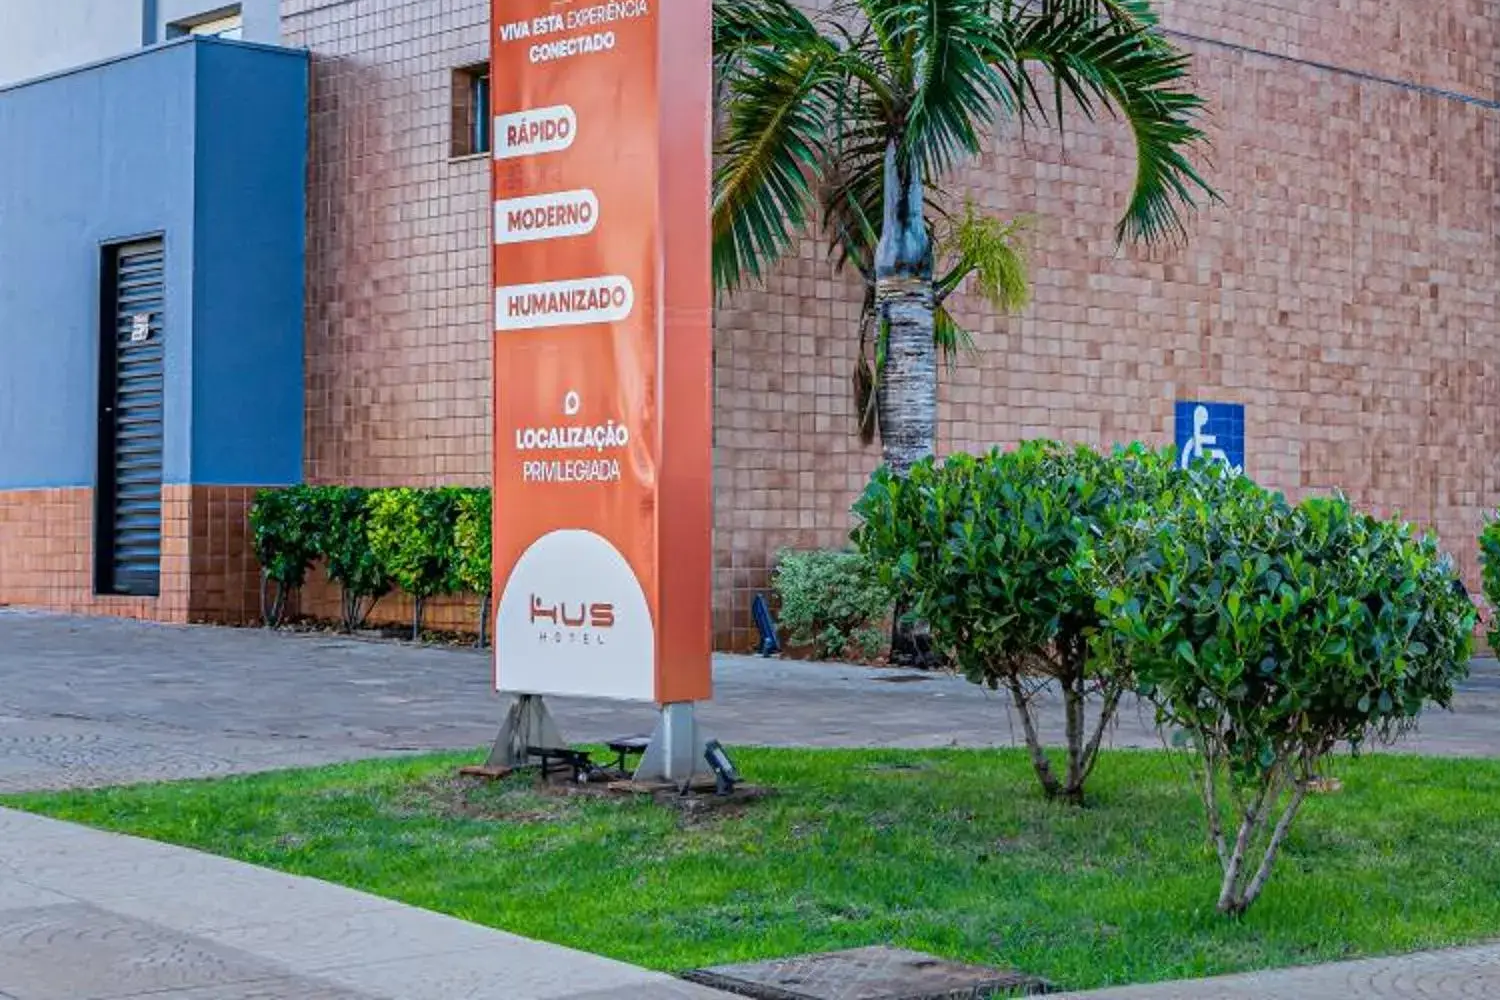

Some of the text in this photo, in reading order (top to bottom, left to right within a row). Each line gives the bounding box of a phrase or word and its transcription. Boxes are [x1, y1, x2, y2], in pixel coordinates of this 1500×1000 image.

[499, 21, 531, 42] VIVA
[532, 13, 565, 35] ESTA
[529, 31, 616, 63] CONECTADO
[507, 116, 570, 147] RÁPIDO
[507, 201, 593, 233] MODERNO
[508, 286, 626, 317] HUMANIZADO
[515, 419, 629, 453] LOCALIZAÇÃO
[523, 459, 621, 482] PRIVILEGIADA
